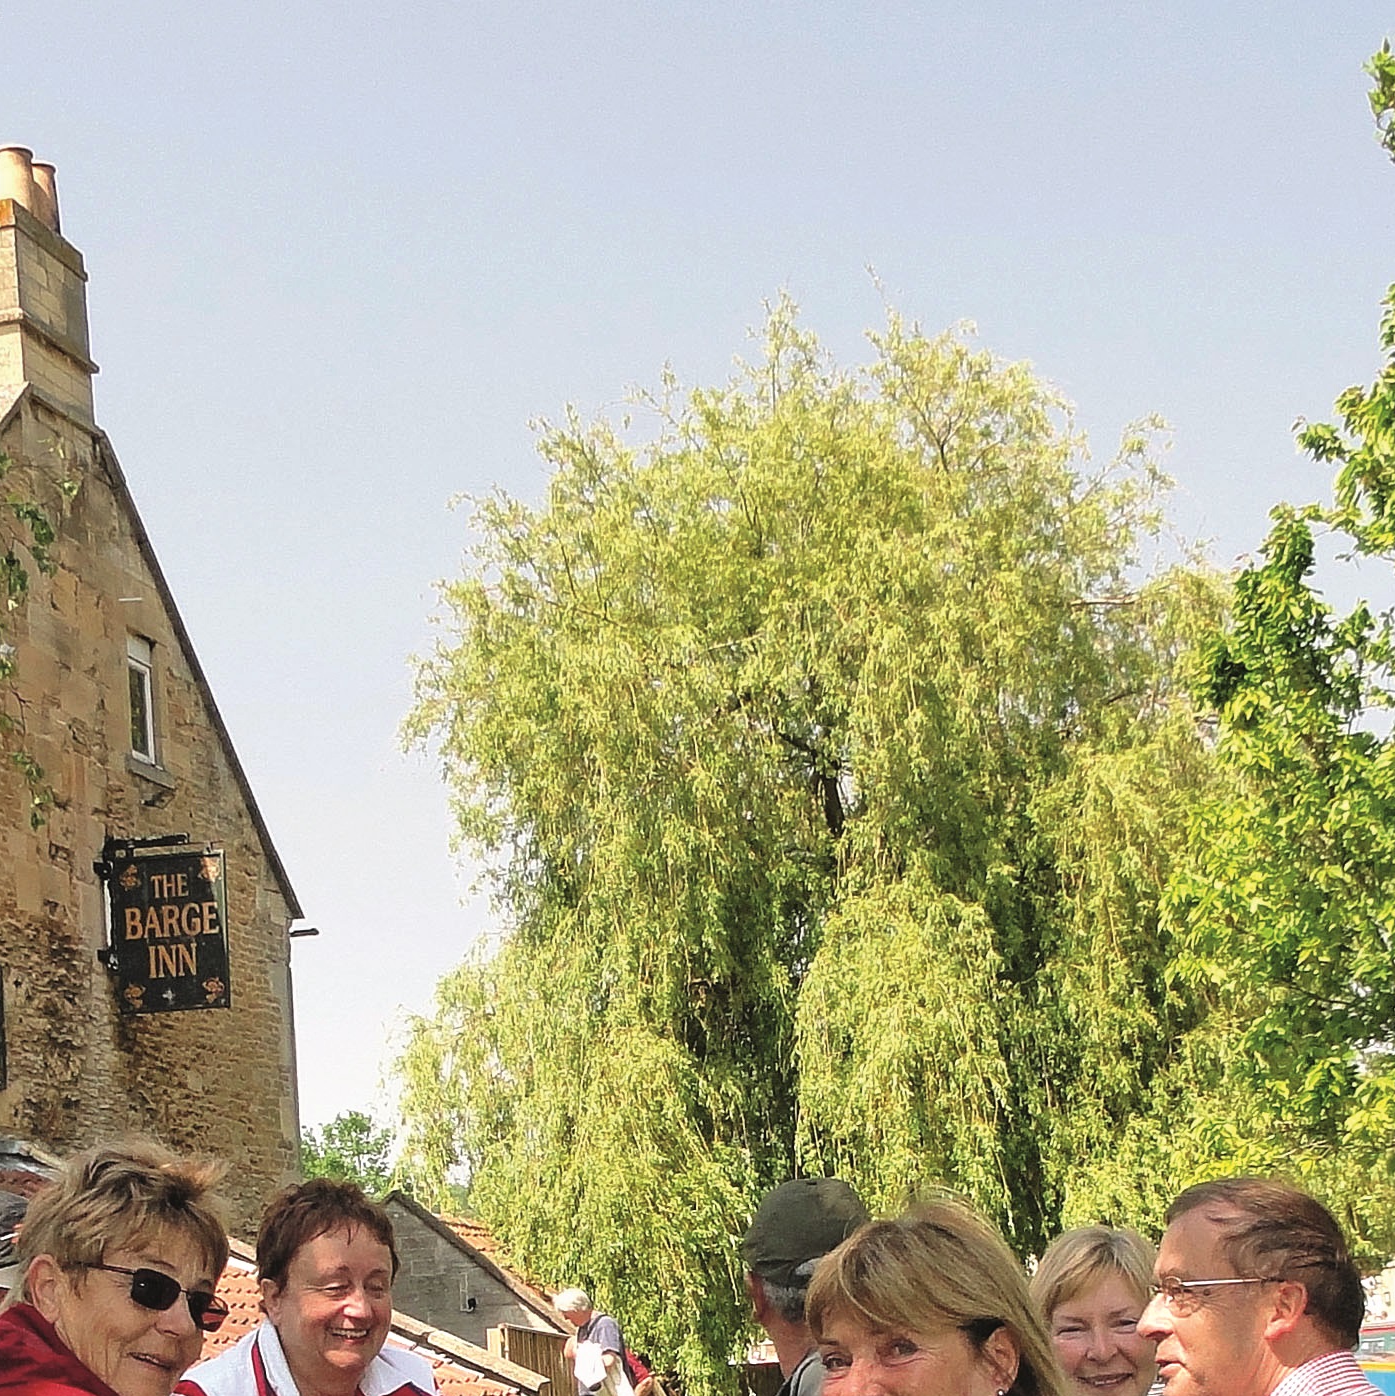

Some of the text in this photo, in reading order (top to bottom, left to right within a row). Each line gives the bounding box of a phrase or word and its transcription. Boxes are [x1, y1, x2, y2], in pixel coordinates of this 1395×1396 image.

[151, 873, 189, 899] THE
[125, 901, 220, 941] BARGE
[149, 943, 198, 979] INN
